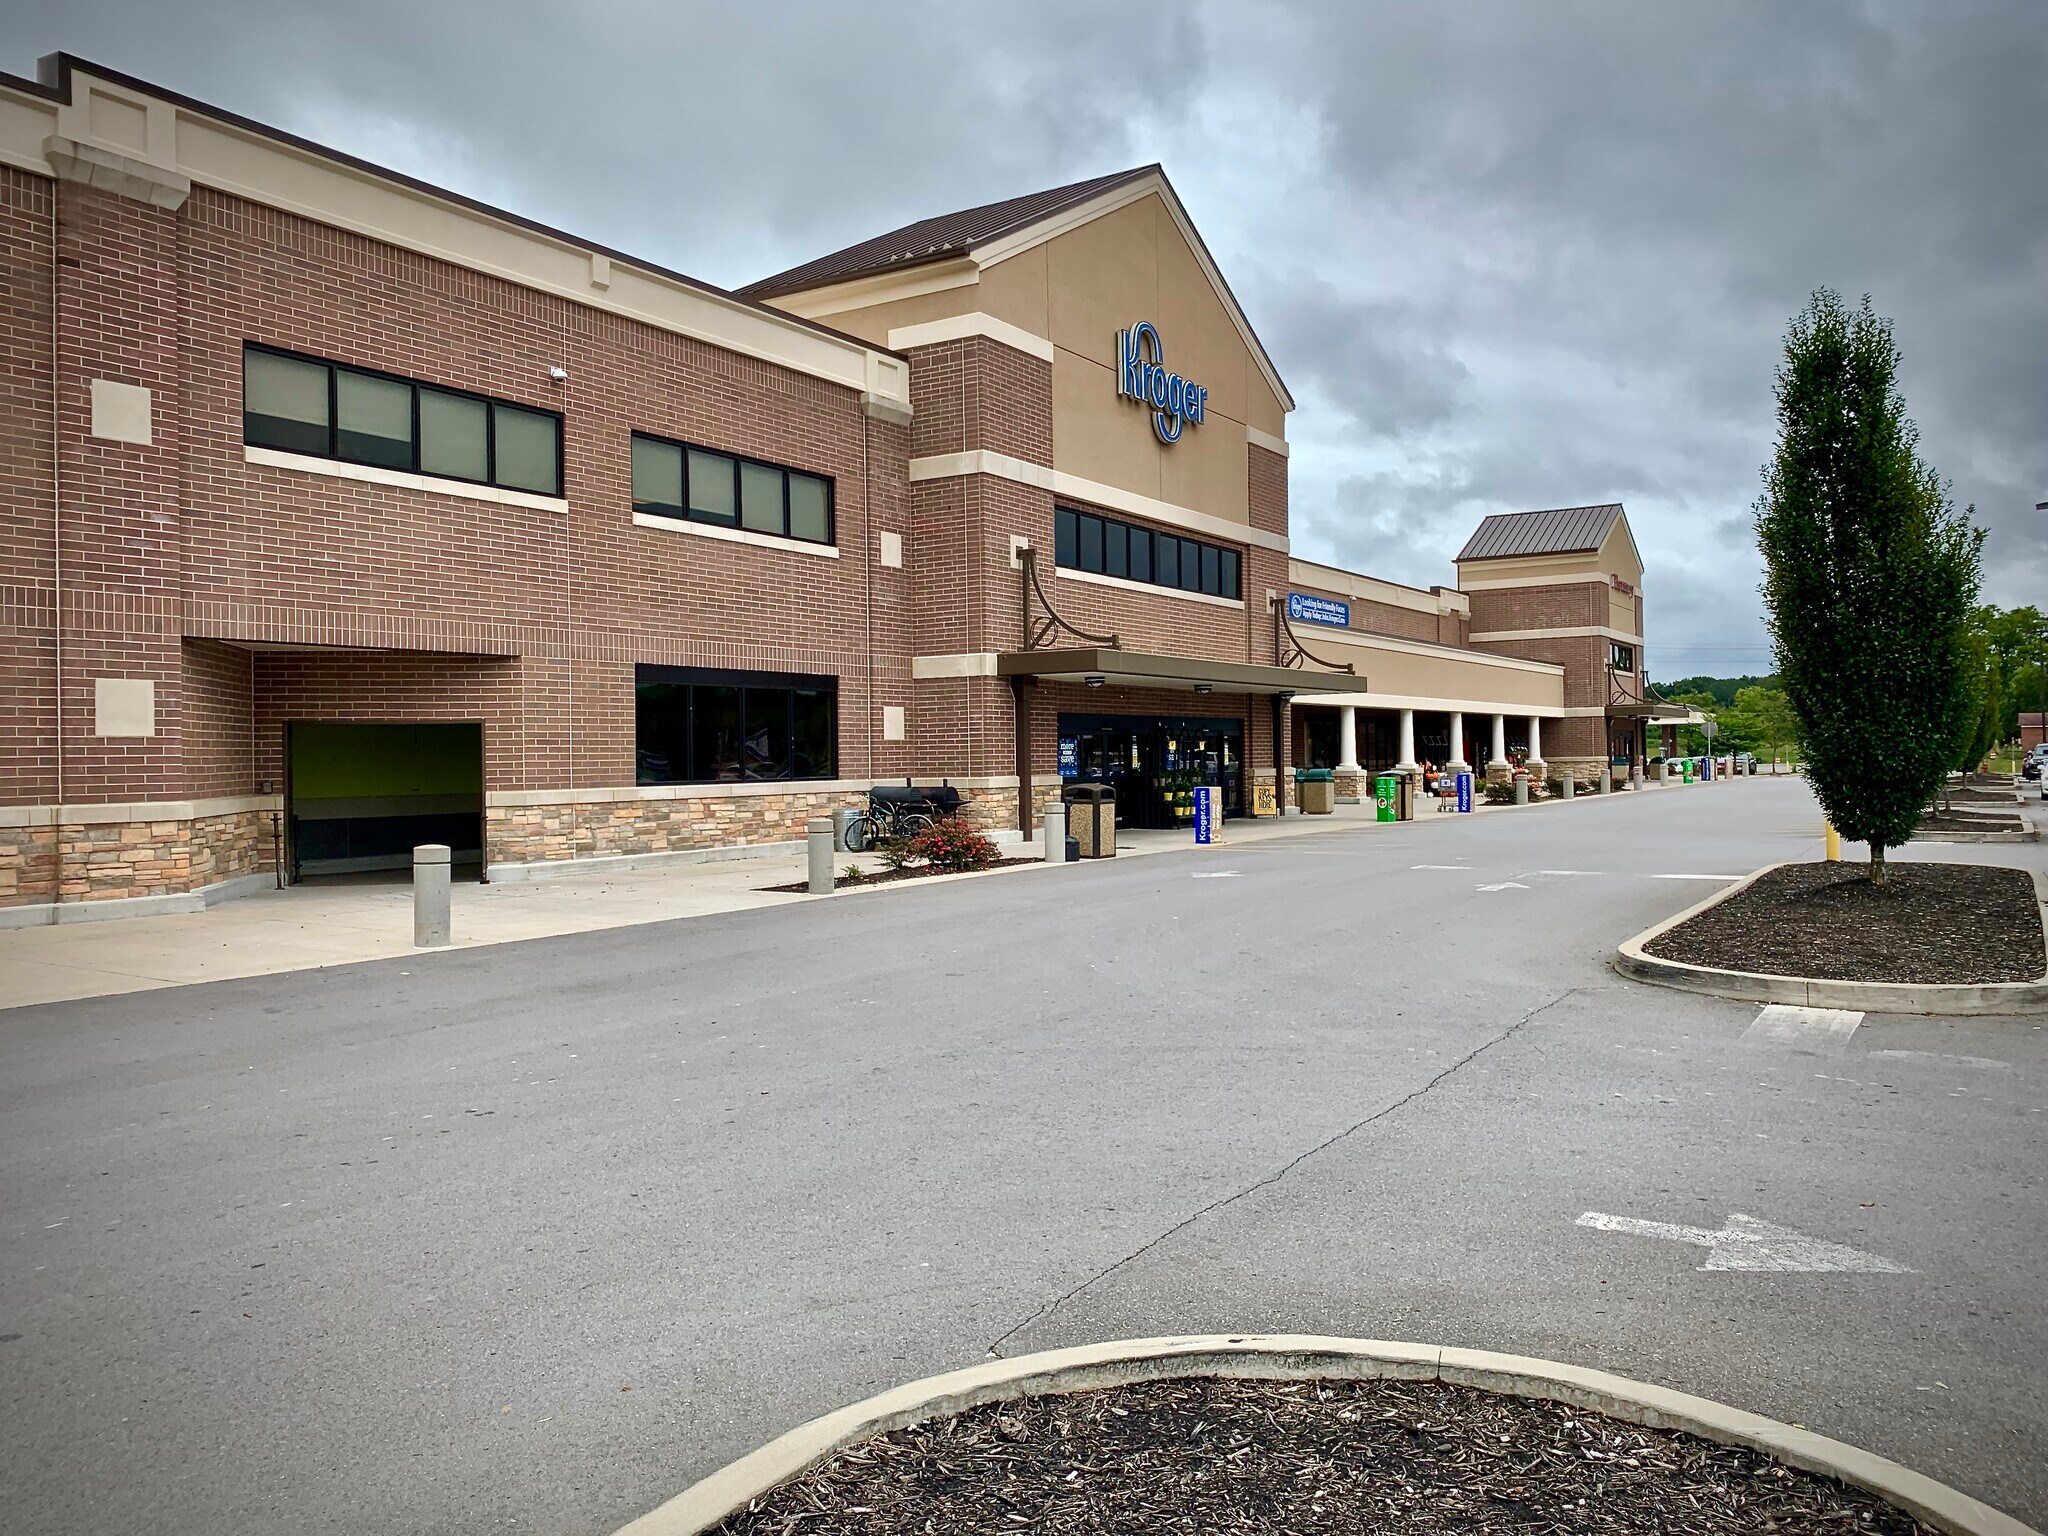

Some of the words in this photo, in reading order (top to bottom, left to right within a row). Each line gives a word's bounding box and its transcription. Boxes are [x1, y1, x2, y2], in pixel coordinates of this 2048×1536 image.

[1116, 321, 1207, 443] Kroger
[1302, 598, 1316, 609] Looking
[1060, 755, 1075, 763] save
[1199, 791, 1207, 841] Kroger.com
